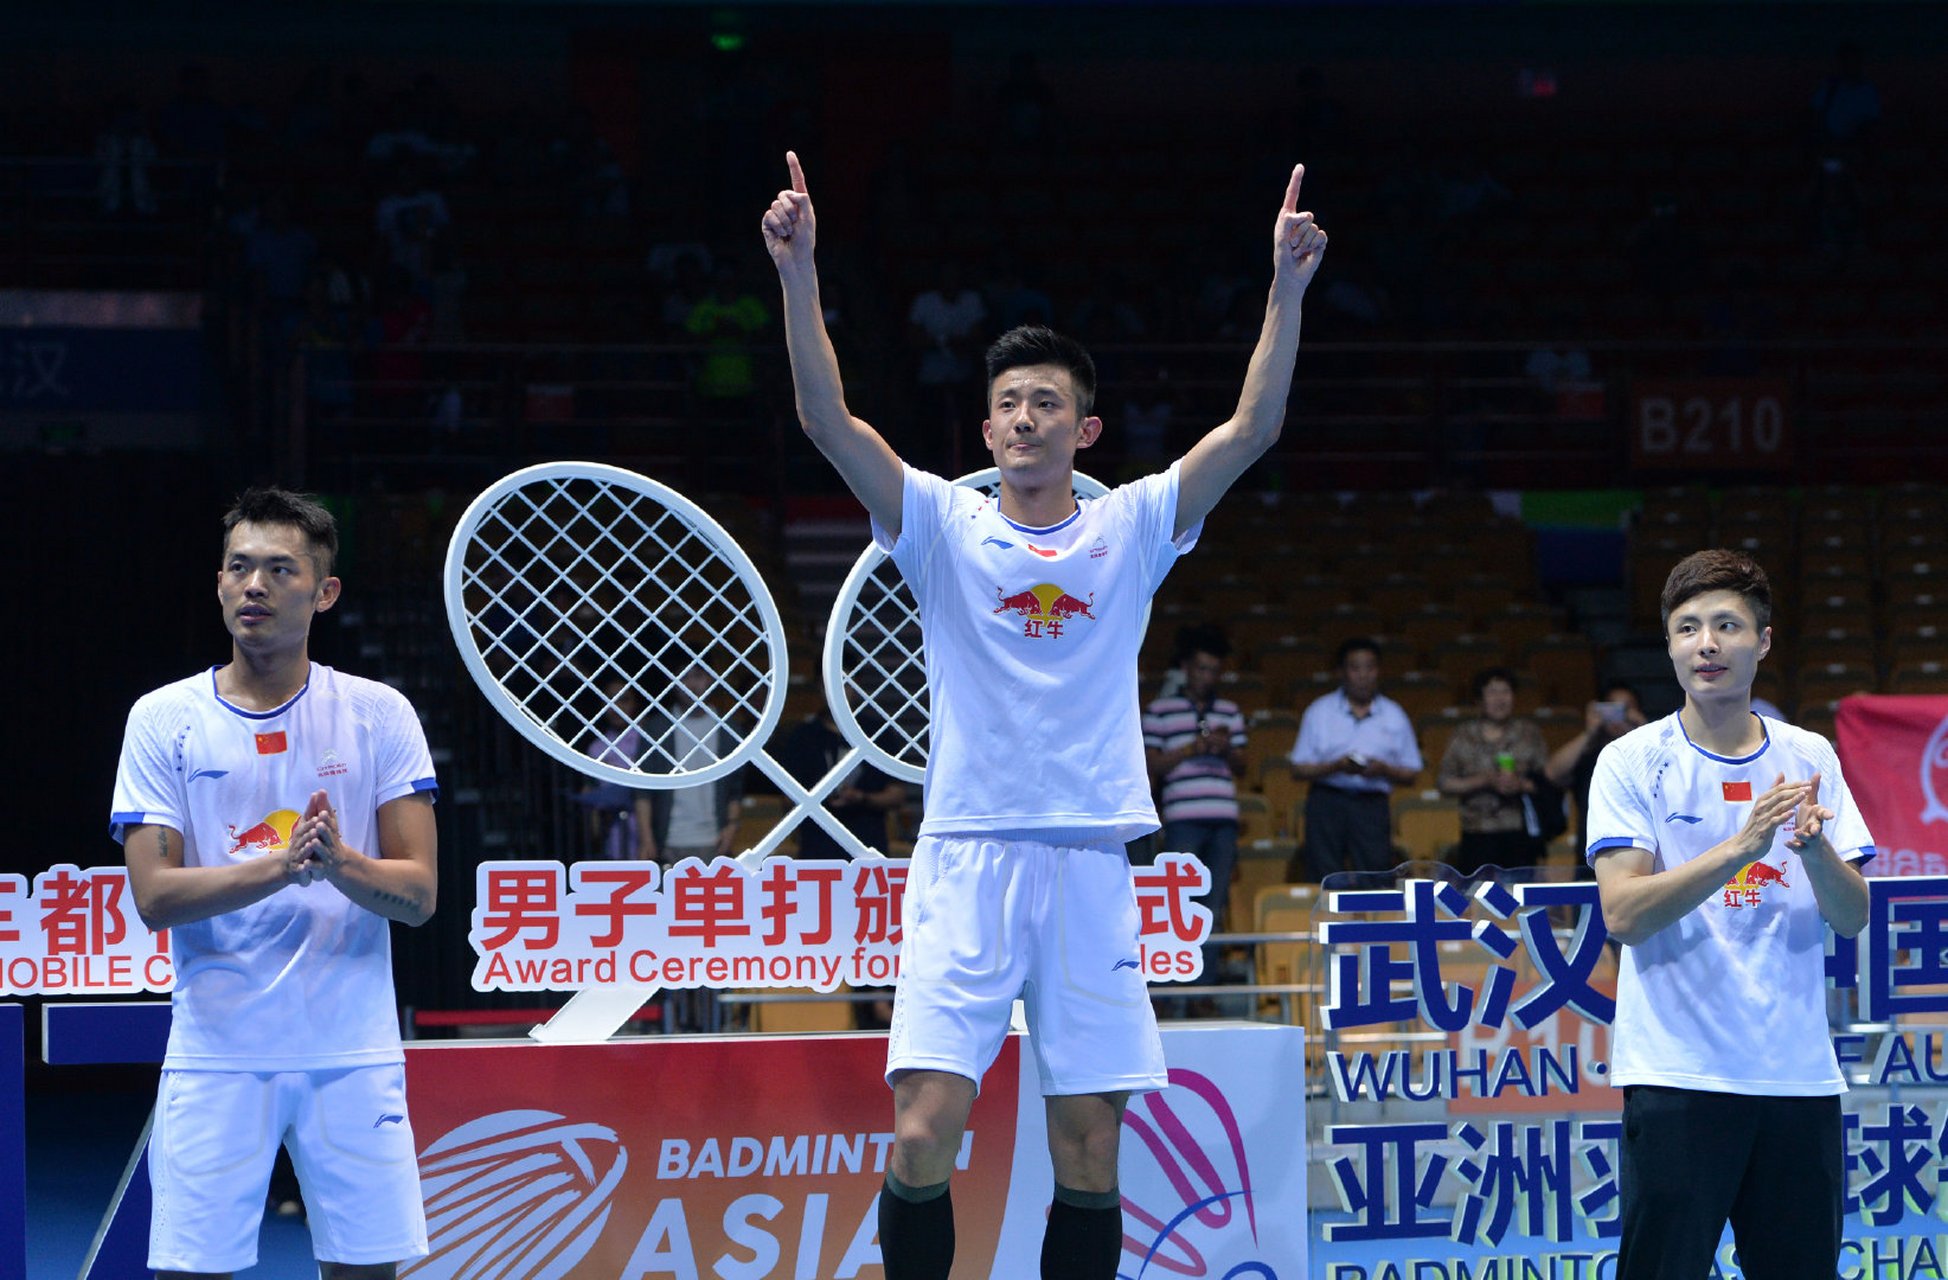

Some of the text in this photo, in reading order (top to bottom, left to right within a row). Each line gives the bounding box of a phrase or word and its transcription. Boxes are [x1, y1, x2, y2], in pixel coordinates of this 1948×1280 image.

[1640, 398, 1785, 455] B210
[1024, 619, 1064, 639] 红牛
[1133, 862, 1204, 942] 式
[1723, 889, 1762, 908] 红牛
[0, 956, 133, 989] OBILE
[483, 951, 617, 985] Award
[629, 949, 843, 987] Ceremony
[1320, 879, 1616, 1033] 武汉
[1328, 1043, 1580, 1103] WUHAN
[656, 1130, 974, 1180] BADMINT
[1843, 1103, 1948, 1228] 球
